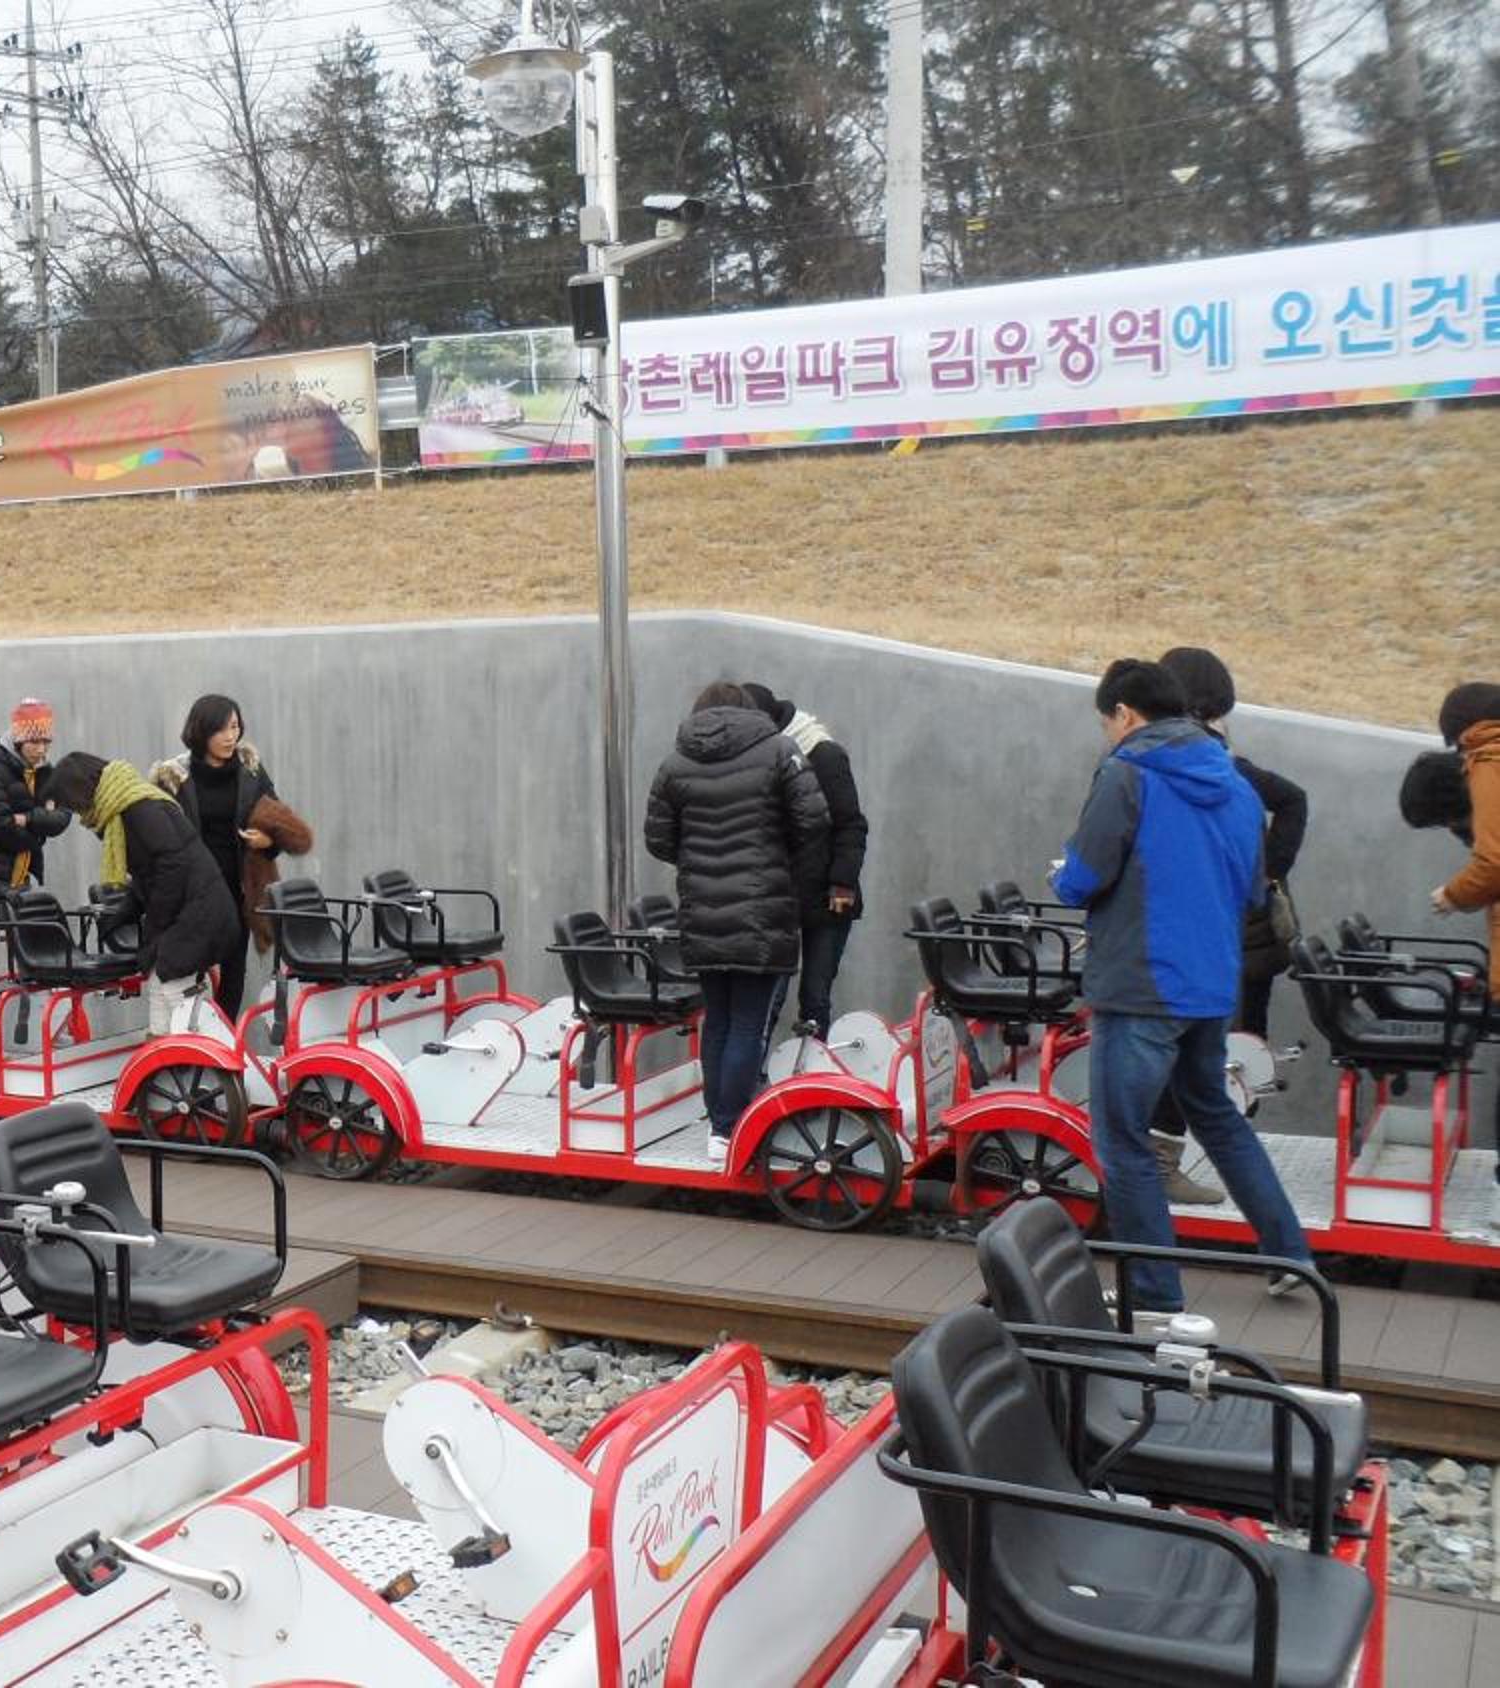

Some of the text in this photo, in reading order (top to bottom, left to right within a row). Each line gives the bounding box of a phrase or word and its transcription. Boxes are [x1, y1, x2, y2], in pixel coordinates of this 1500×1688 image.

[621, 334, 900, 412] 촌레일파크
[927, 299, 1230, 388] 김유정역에
[225, 370, 327, 400] make your
[243, 391, 367, 427] memories
